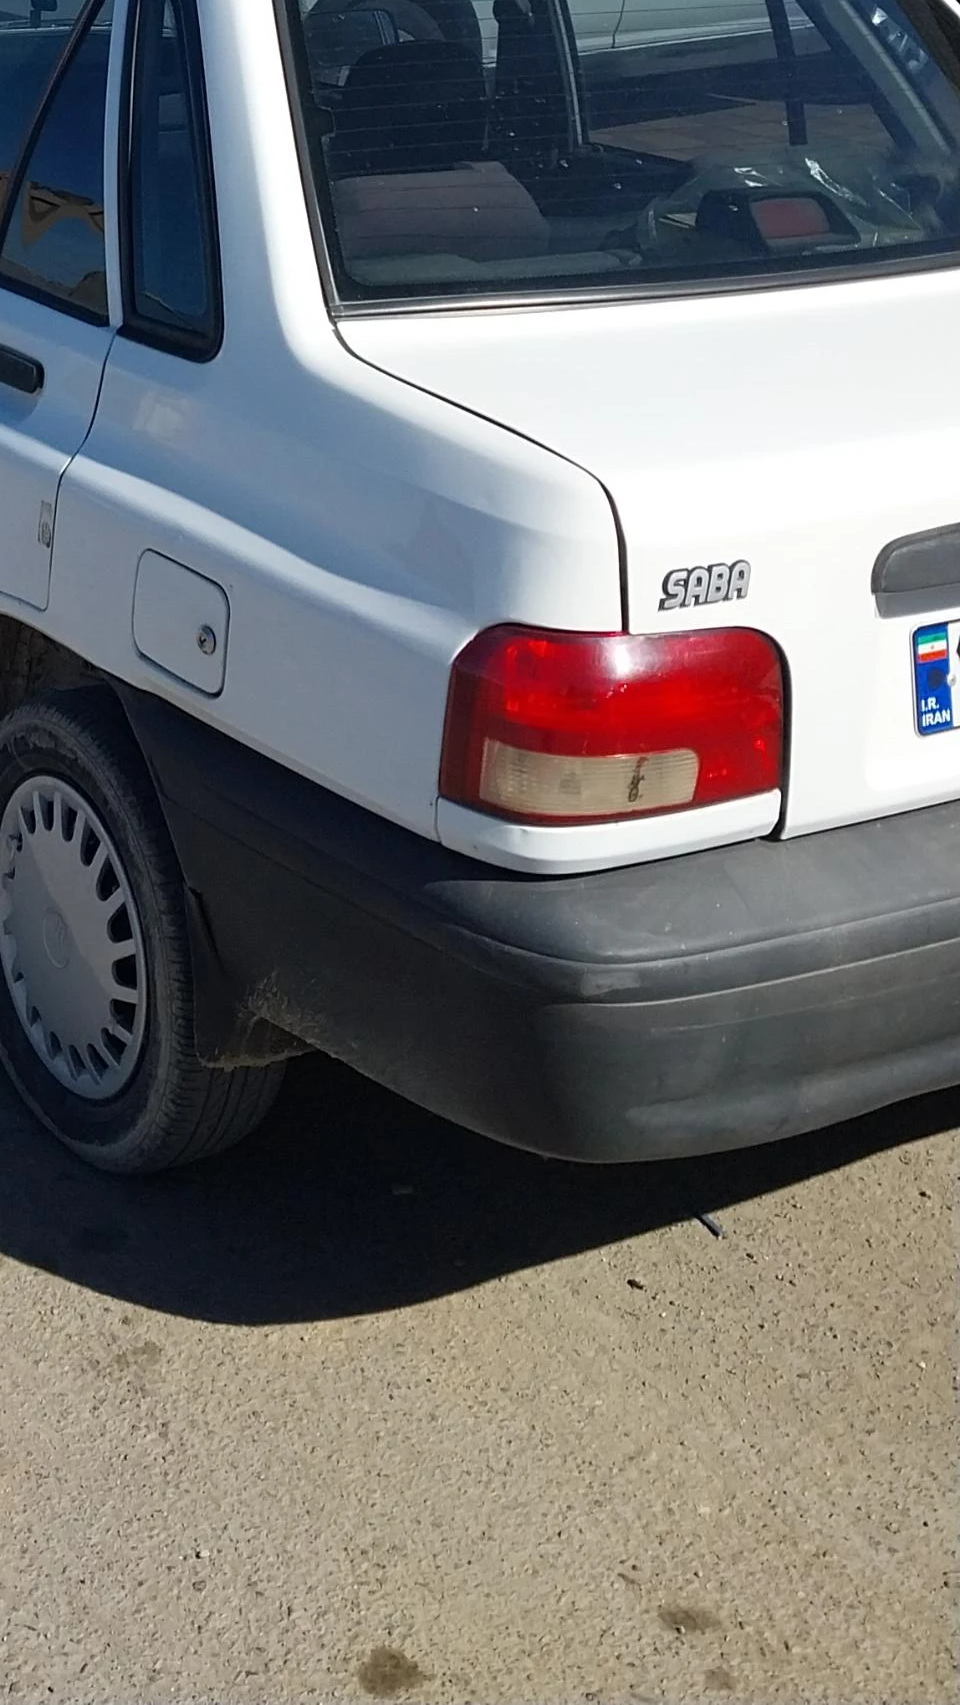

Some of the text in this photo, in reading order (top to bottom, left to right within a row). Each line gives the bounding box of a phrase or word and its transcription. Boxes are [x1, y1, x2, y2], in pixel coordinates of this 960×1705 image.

[658, 559, 751, 612] SABA
[921, 696, 940, 712] I.R.
[922, 709, 951, 727] IRAN
